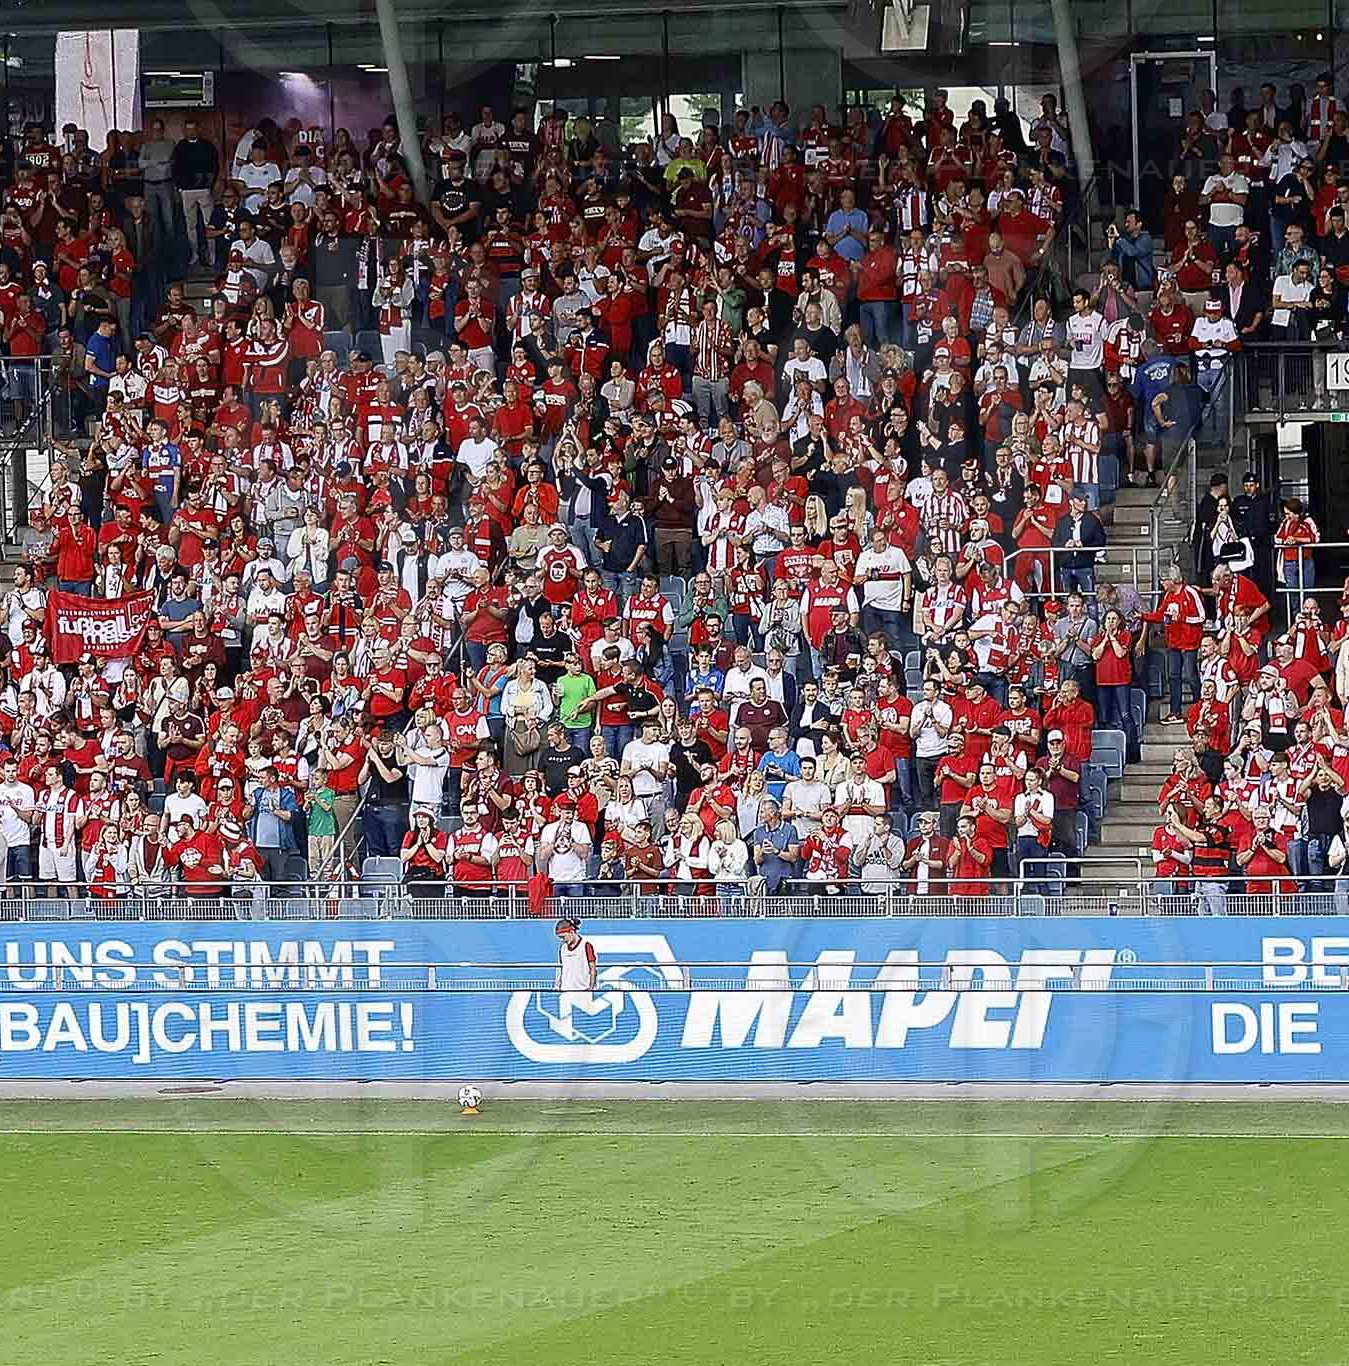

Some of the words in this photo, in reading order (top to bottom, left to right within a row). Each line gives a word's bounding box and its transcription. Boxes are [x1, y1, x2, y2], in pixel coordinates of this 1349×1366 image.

[6, 941, 135, 990] UNS
[153, 940, 395, 990] STIMMT
[681, 950, 1112, 1049] MAPEI
[1212, 1003, 1322, 1054] DIE
